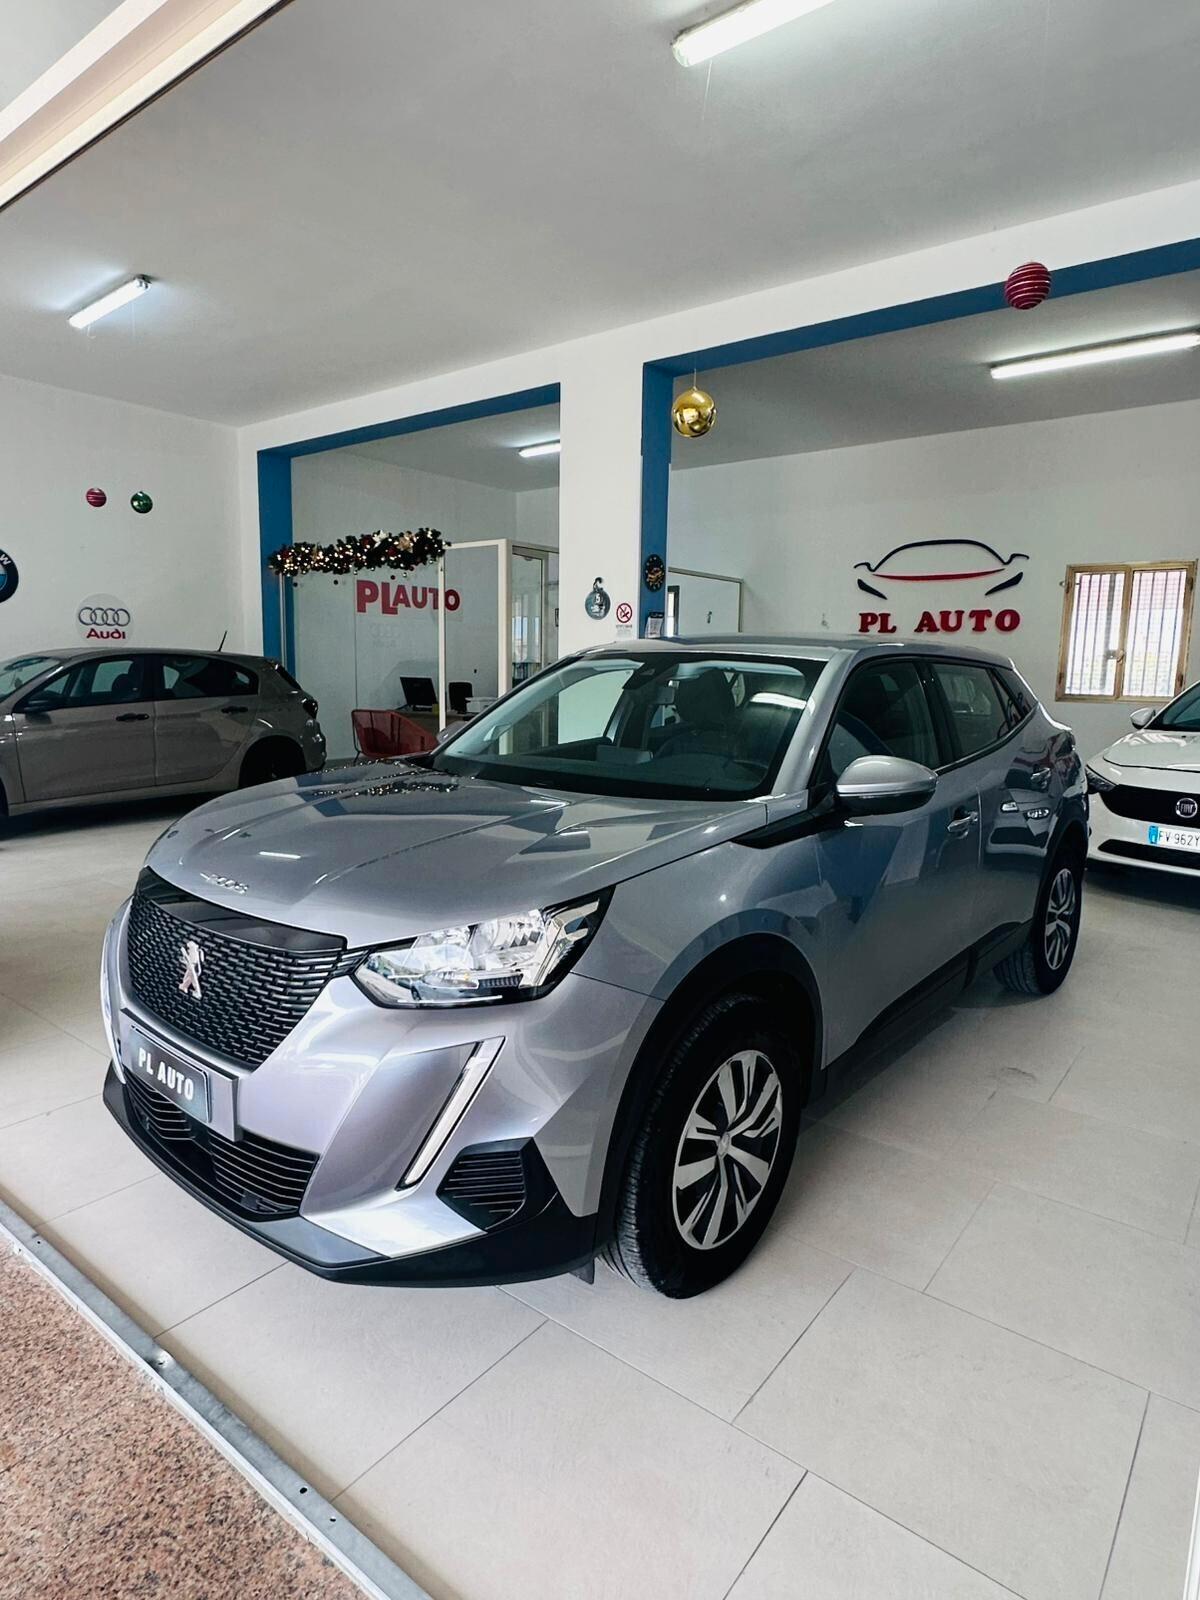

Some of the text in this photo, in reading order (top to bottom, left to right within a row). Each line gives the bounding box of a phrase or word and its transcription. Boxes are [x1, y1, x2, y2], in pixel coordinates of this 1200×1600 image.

[858, 608, 1021, 634] PL AUTO
[86, 627, 126, 640] Audi
[1180, 803, 1194, 814] FIAT
[138, 1047, 194, 1101] PL AUTO
